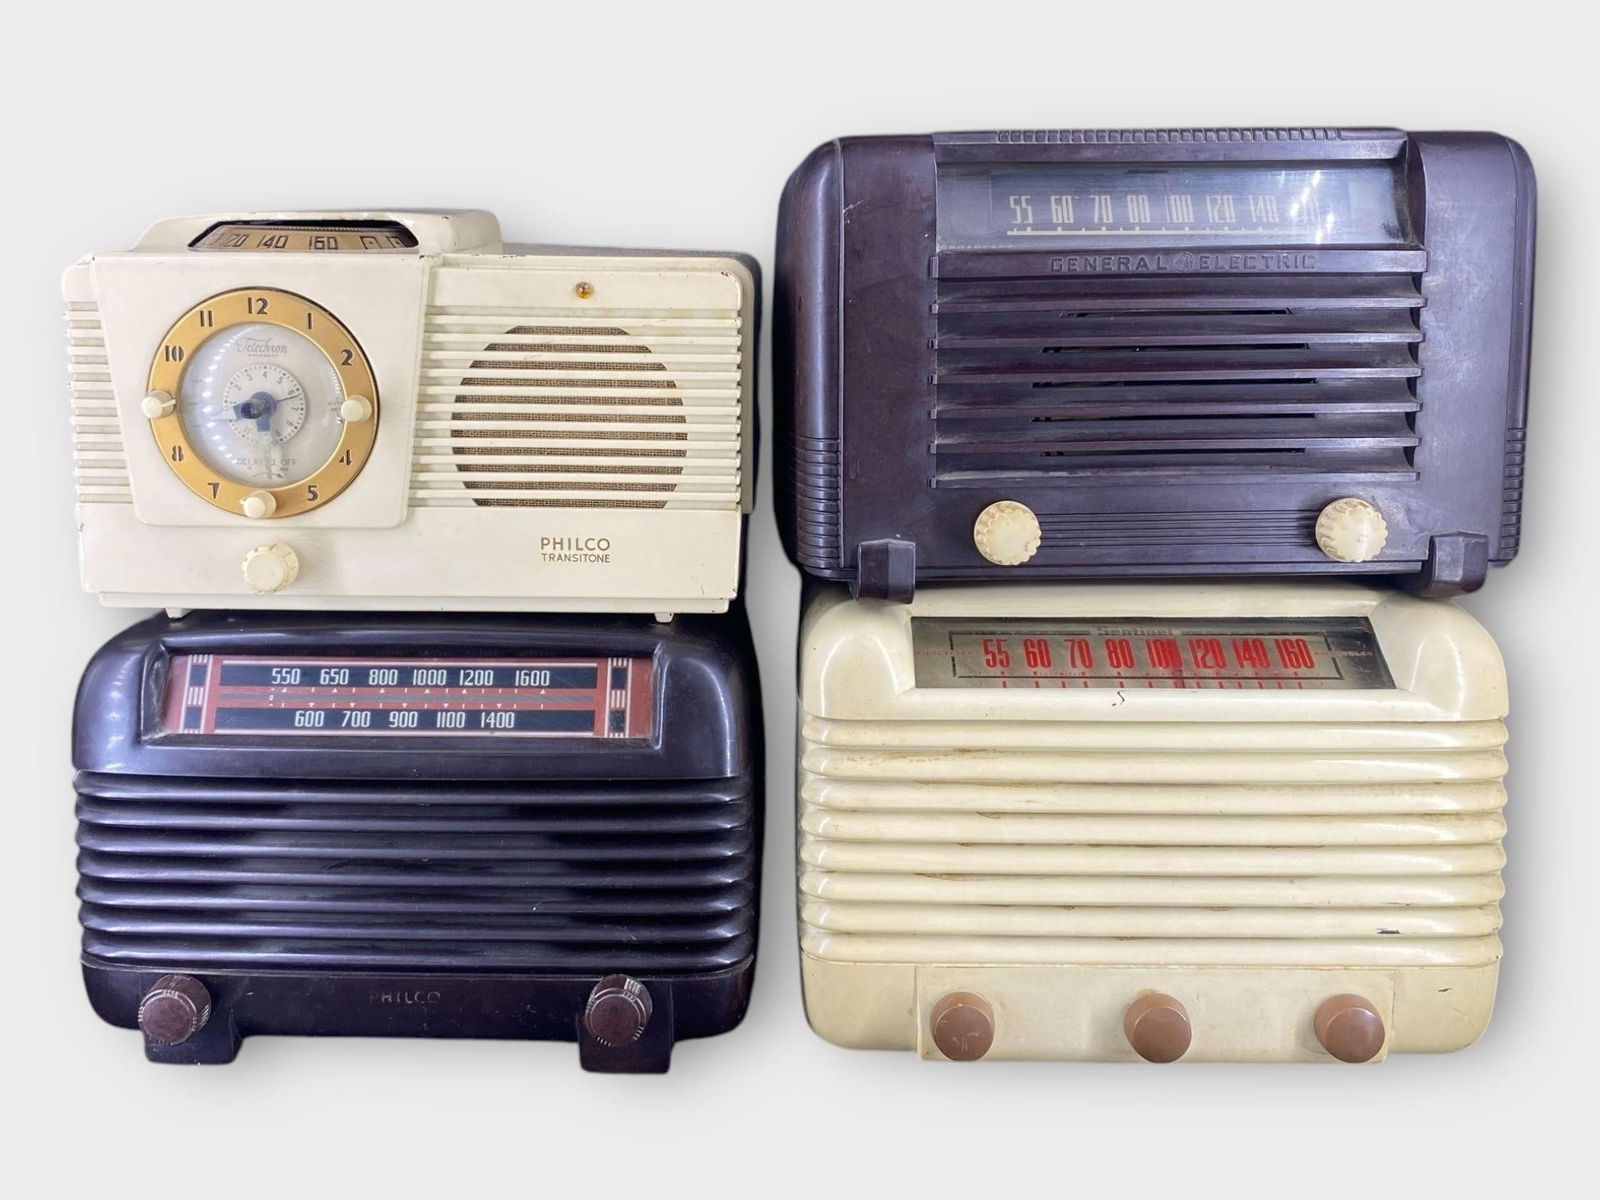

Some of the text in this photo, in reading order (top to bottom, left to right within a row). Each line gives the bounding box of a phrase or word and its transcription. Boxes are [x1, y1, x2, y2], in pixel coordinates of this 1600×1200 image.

[1009, 195, 1033, 224] 55
[1050, 195, 1074, 223] 60
[1090, 195, 1113, 223] 70
[1127, 195, 1150, 223] 80
[1163, 194, 1194, 223] 100
[1206, 194, 1236, 223] 120
[1251, 194, 1279, 223] 140
[257, 234, 288, 249] 140
[309, 235, 338, 250] 160
[1050, 255, 1168, 273] GENERAL
[1199, 254, 1316, 271] ELECTRIC
[247, 296, 269, 315] 12
[200, 310, 213, 328] 11
[307, 312, 313, 330] 1
[164, 344, 185, 362] 10
[340, 349, 354, 366] 2
[171, 445, 184, 462] 8
[339, 449, 351, 466] 4
[208, 482, 220, 499] 7
[307, 485, 319, 502] 5
[540, 537, 611, 551] PHILCO
[541, 553, 611, 563] TRANSITONE
[981, 638, 1315, 669] 55 60 70 80 100 120 140 160
[271, 668, 550, 686] 550 650 800 1000 1200 1600
[294, 710, 515, 728] 600 700 900 1100 1400
[369, 991, 441, 1004] PHILCO
